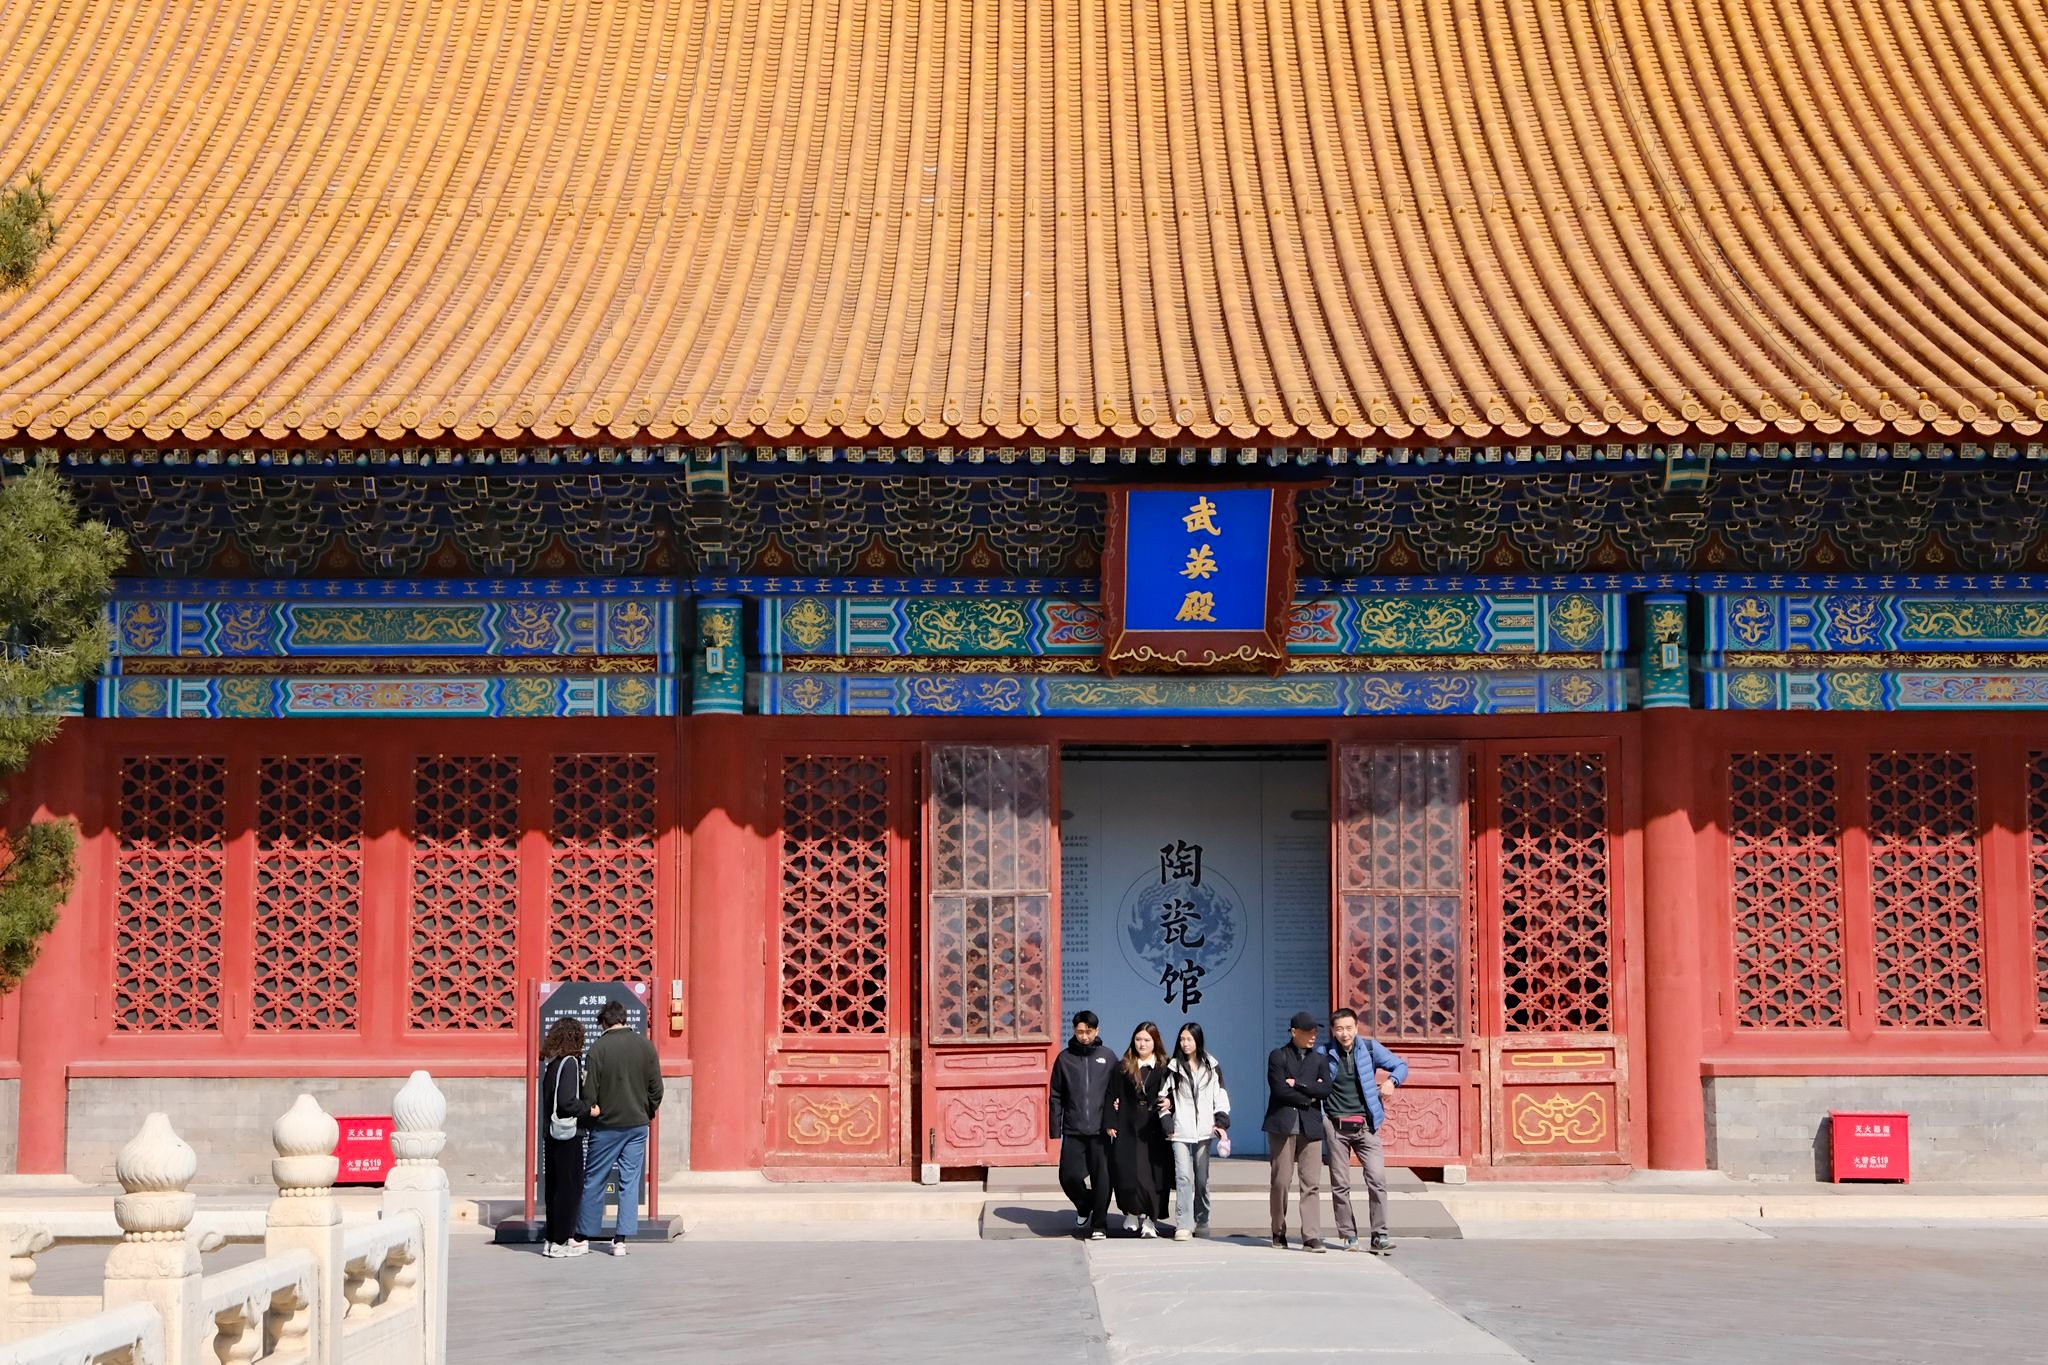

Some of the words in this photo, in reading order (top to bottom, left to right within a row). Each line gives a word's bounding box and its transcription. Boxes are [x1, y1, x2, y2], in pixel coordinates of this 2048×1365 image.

[1175, 496, 1221, 622] 武英殿
[1160, 839, 1206, 1014] 陶瓷馆
[579, 995, 607, 1005] 武英殿
